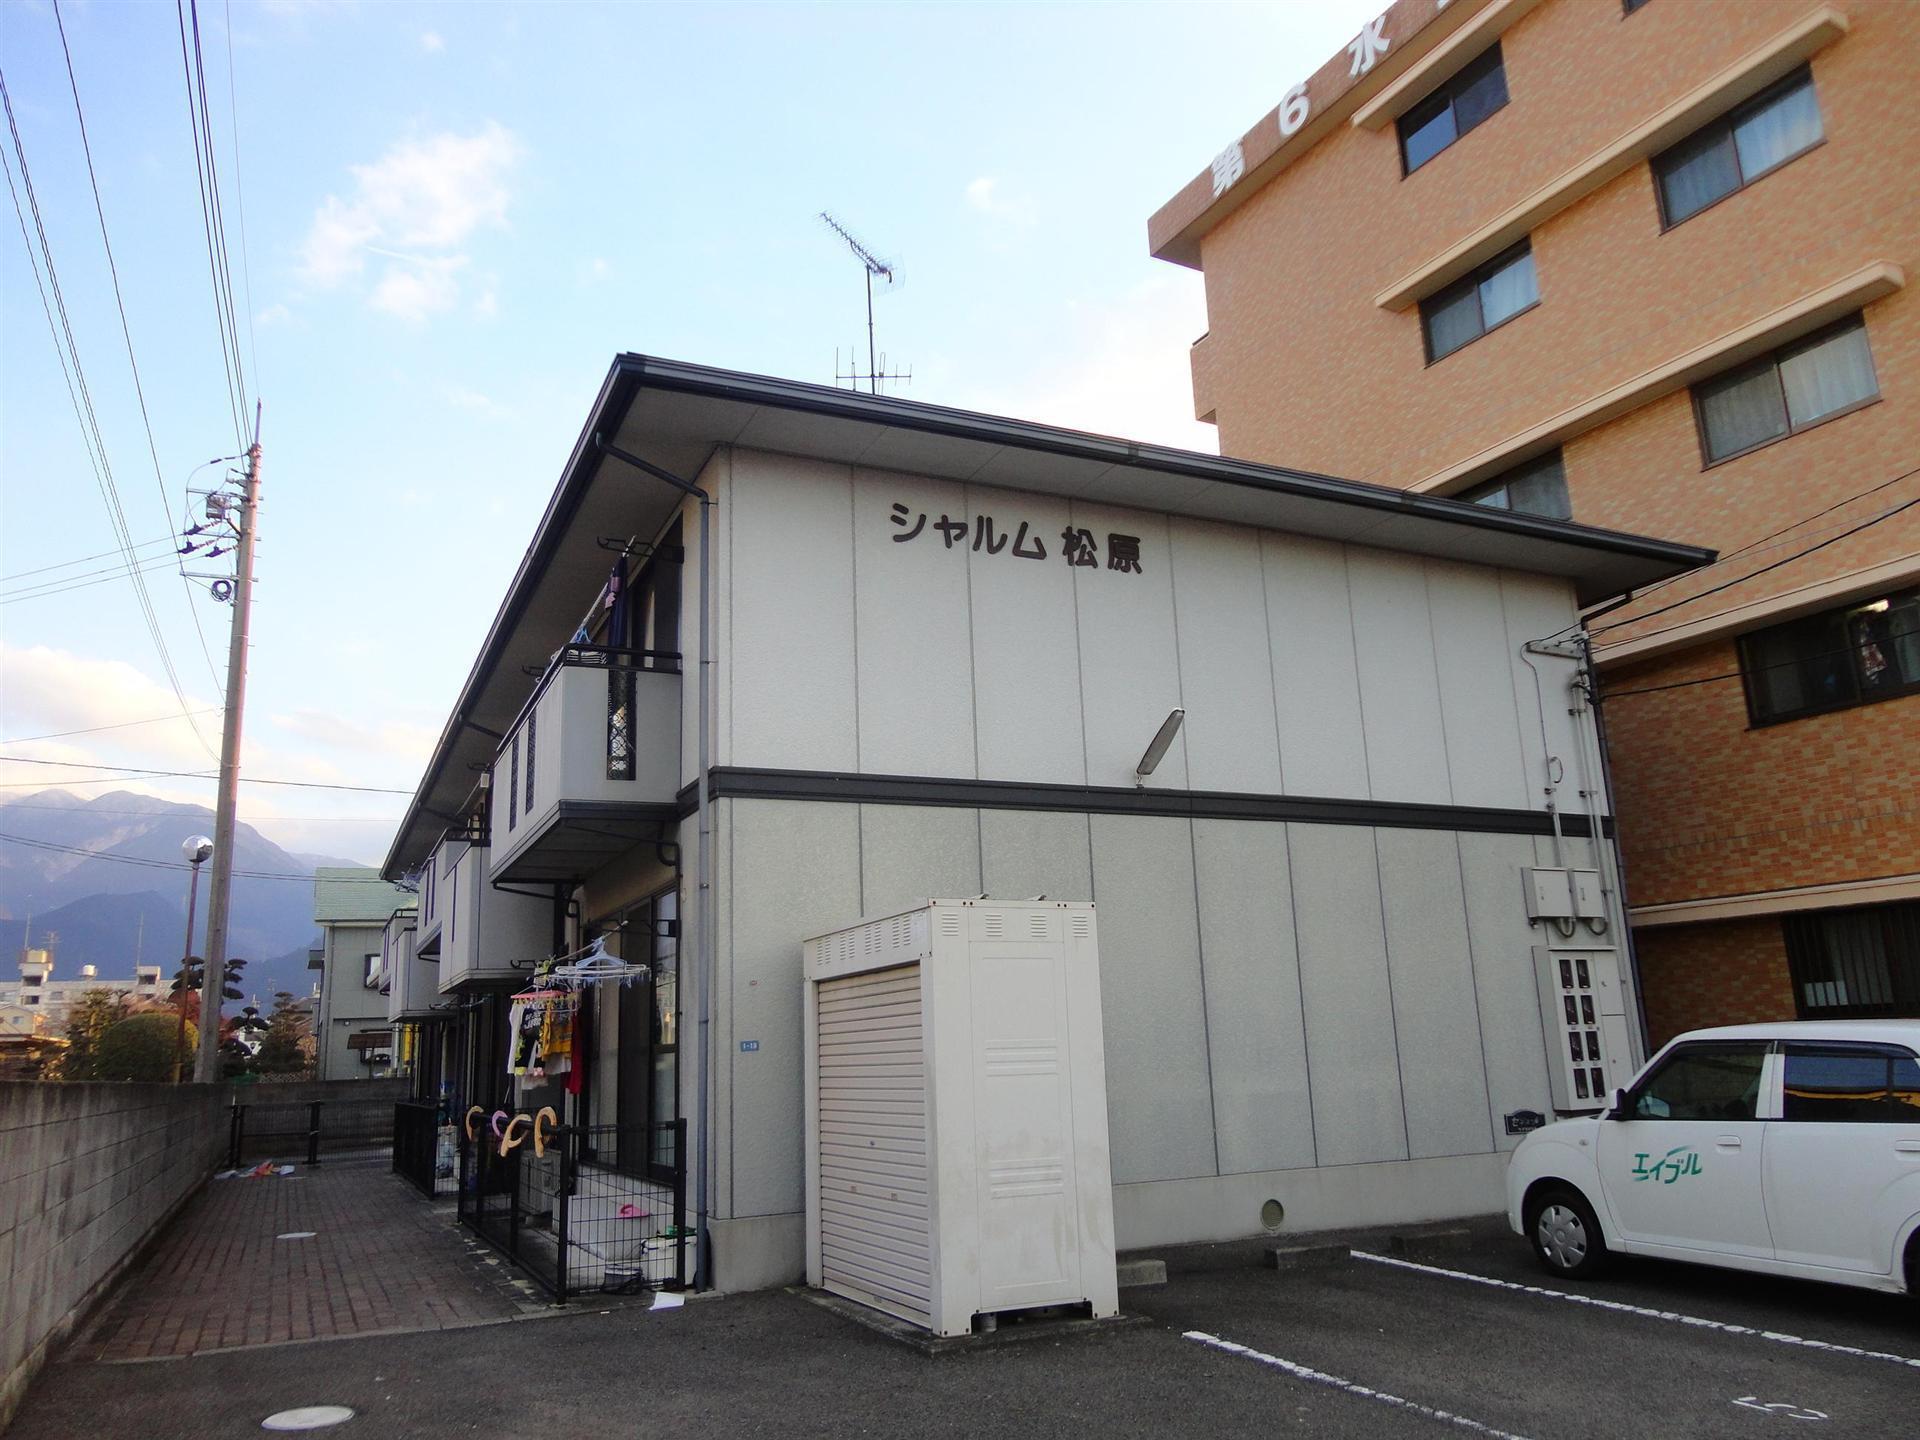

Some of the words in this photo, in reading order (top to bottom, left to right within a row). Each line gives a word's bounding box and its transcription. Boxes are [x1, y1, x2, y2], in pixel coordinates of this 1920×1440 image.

[891, 502, 1143, 575] シャルム松原
[1631, 1150, 1703, 1185] エイブル
